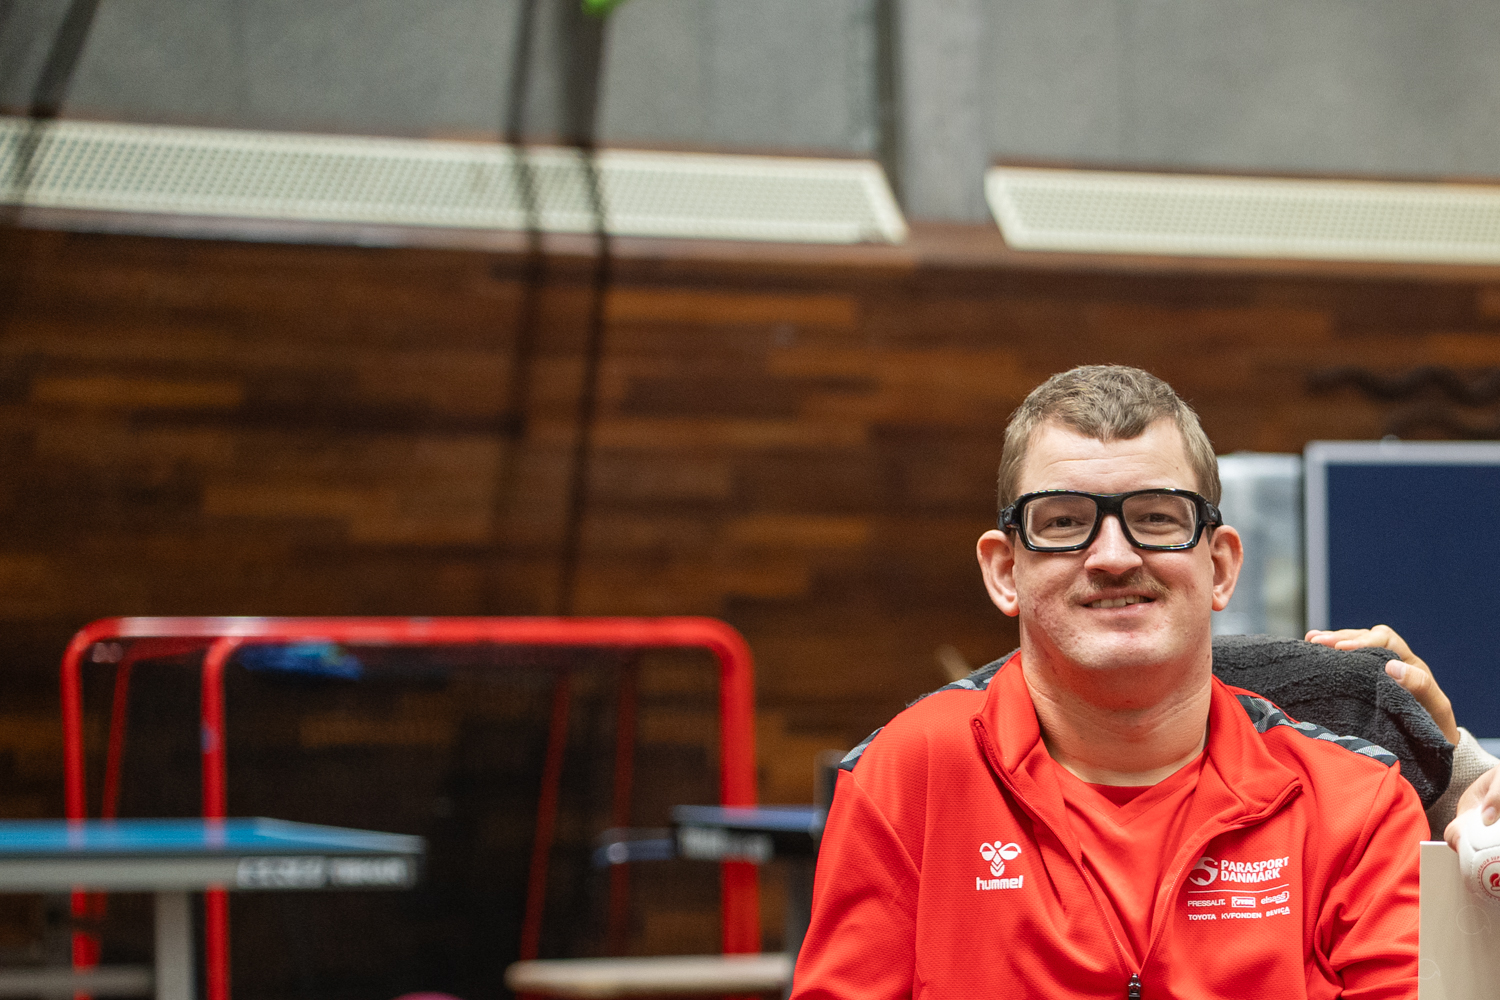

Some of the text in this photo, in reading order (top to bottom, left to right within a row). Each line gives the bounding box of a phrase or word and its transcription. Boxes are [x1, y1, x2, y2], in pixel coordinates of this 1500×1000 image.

[1221, 856, 1289, 873] PARASPORT
[975, 874, 1024, 891] hummel
[1221, 868, 1281, 883] DANMARK
